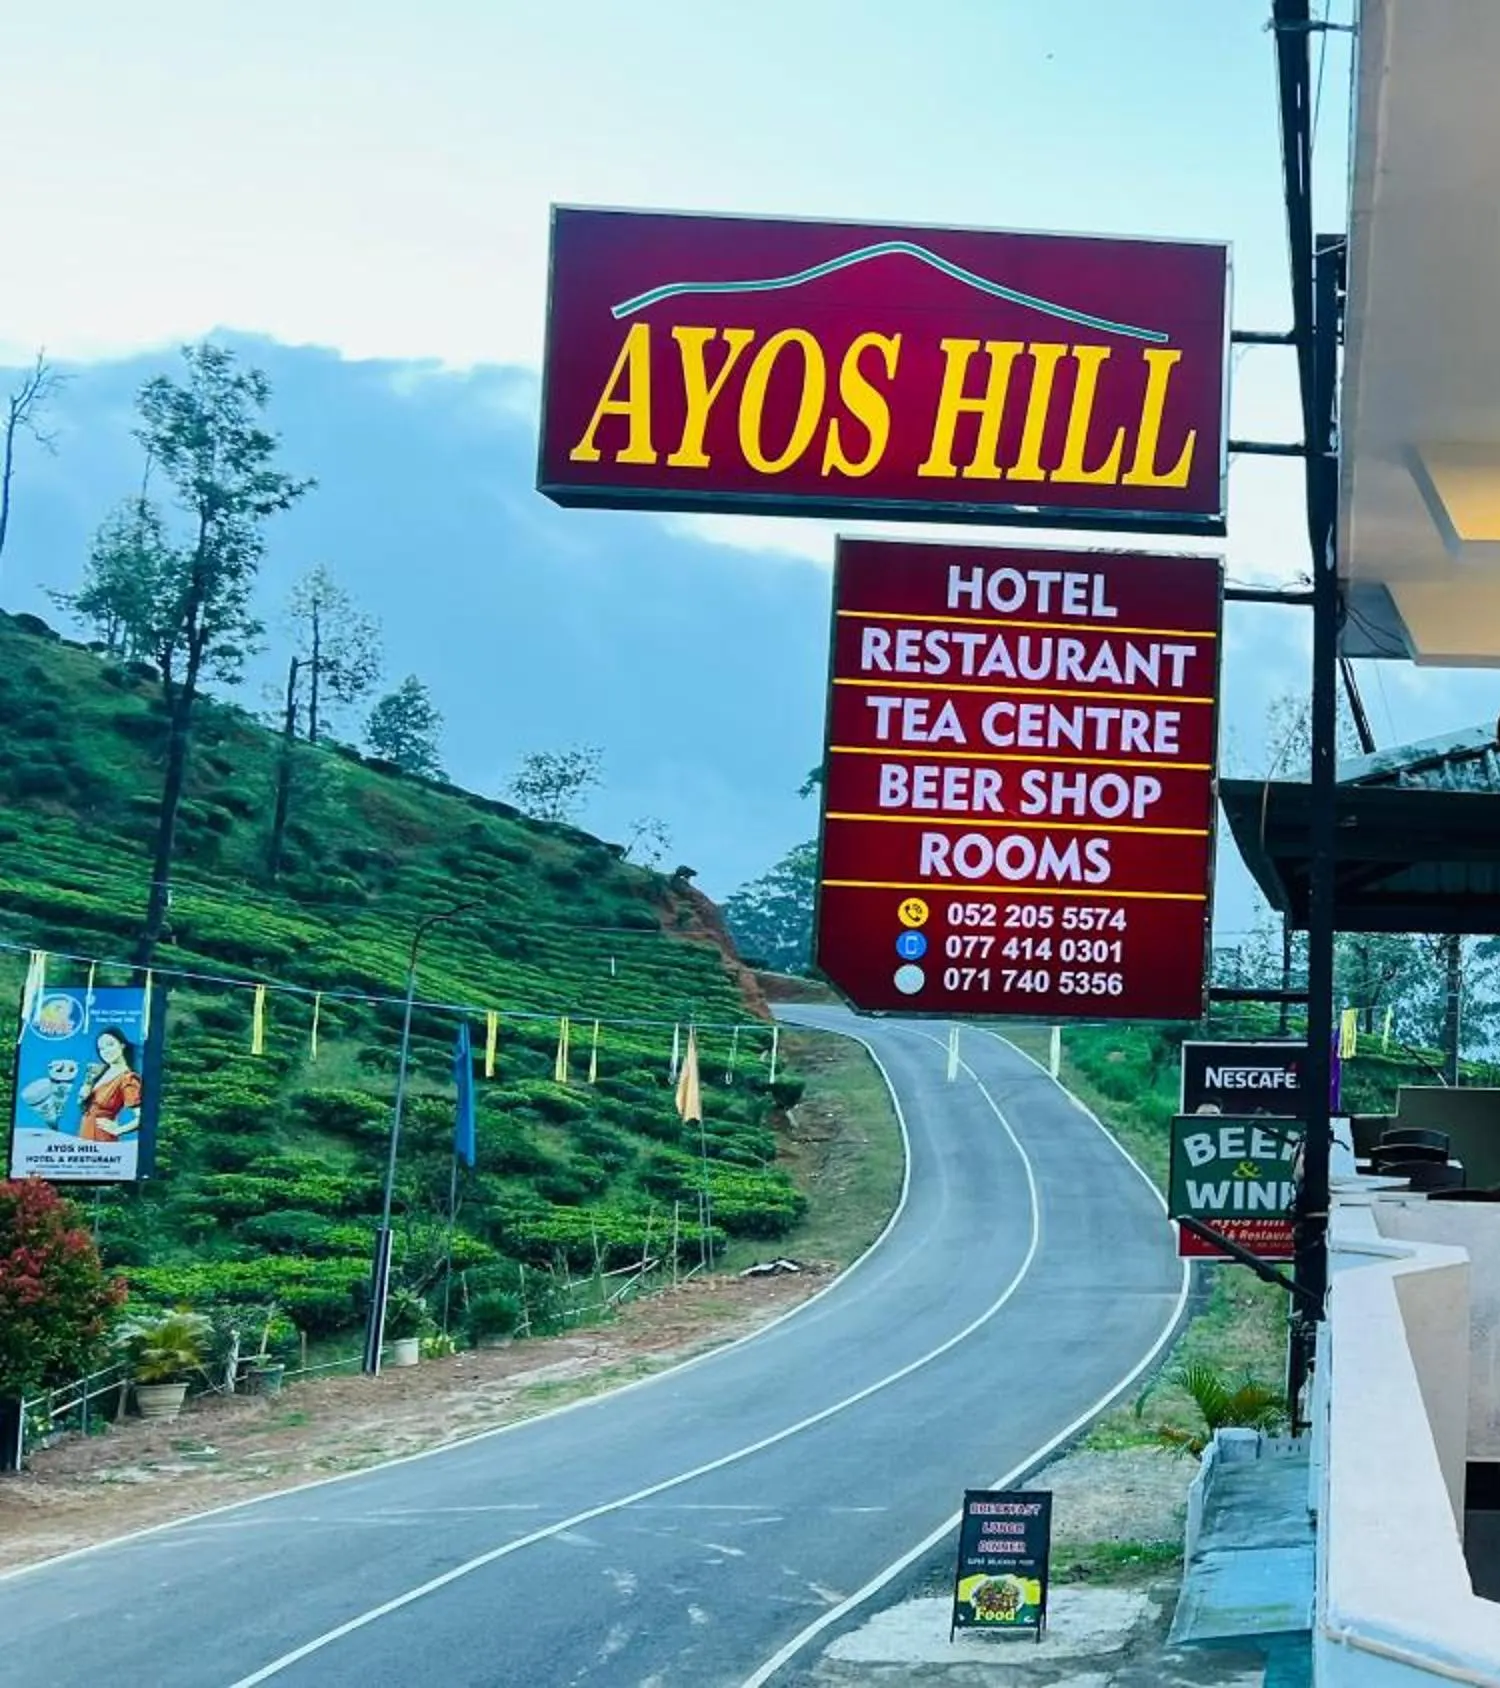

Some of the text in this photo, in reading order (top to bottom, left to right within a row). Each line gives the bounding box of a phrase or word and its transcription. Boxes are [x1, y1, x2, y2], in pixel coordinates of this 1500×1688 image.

[569, 322, 1197, 489] AYOS HILL
[948, 565, 1118, 617] HOTEL
[861, 627, 1197, 688] RESTAURANT
[866, 695, 1181, 754] TEA CENTRE
[879, 764, 1162, 819] BEER SHOP
[920, 833, 1111, 884] ROOMS
[947, 903, 1127, 931] 052 205 5574
[945, 934, 1123, 962] 077 414 0301
[944, 967, 1124, 995] 071 740 5356
[25, 1155, 56, 1163] HOTEL
[46, 1144, 74, 1153] AYOS
[1232, 1161, 1261, 1178] &
[974, 1608, 1016, 1621] Food
